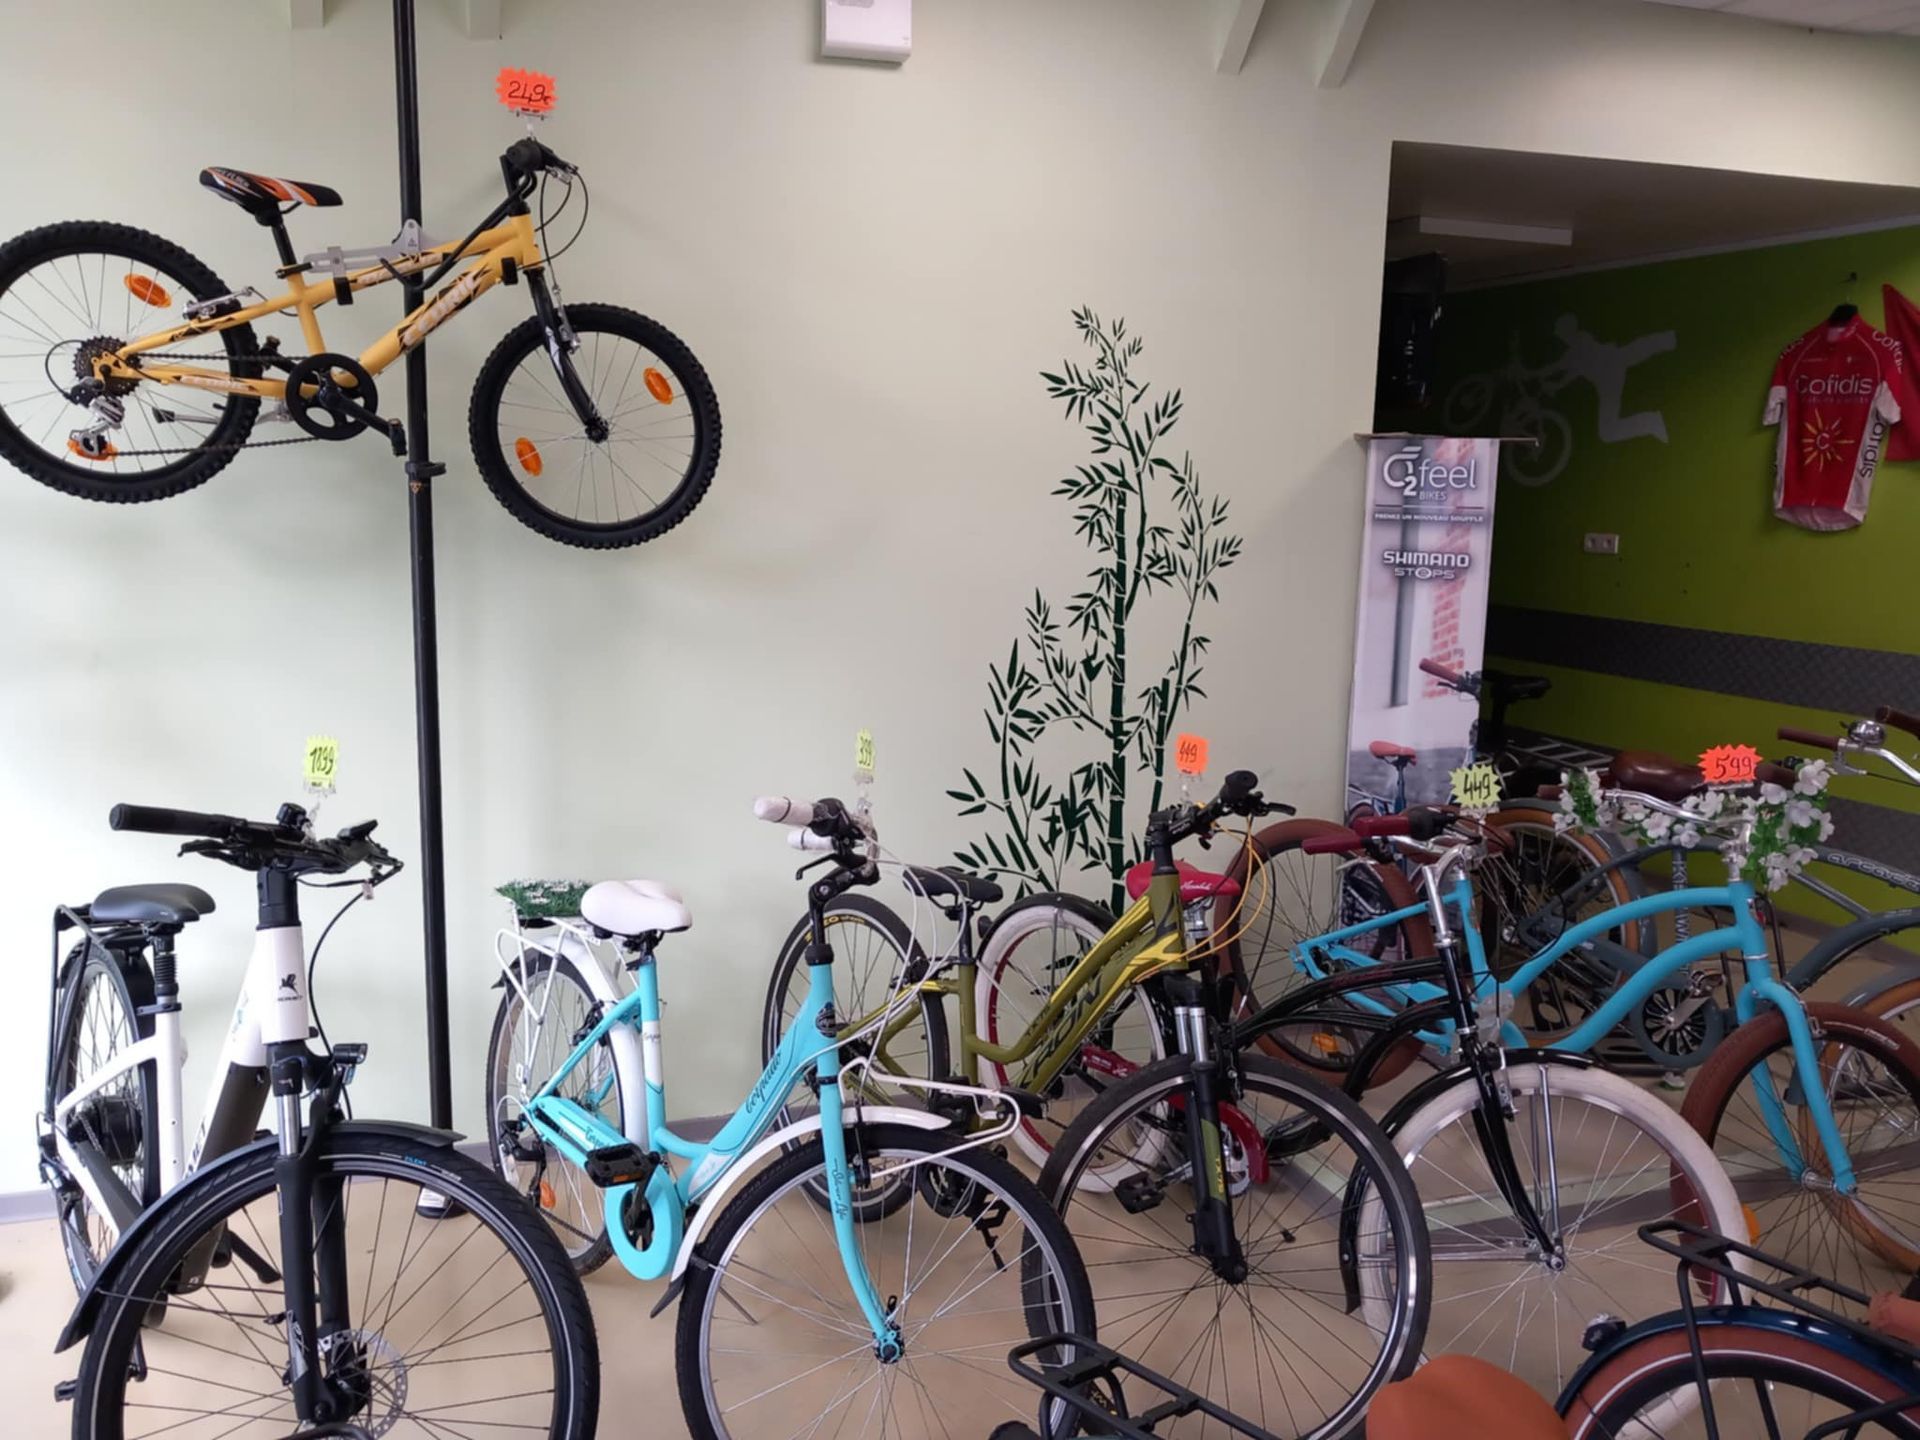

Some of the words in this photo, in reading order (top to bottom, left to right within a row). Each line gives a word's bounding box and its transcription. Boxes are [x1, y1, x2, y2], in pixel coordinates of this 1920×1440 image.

[1796, 374, 1873, 394] Cofidis
[1419, 491, 1447, 501] BIKES
[1383, 551, 1470, 568] SHIMANO
[1713, 754, 1752, 779] 599
[1463, 772, 1491, 800] 449
